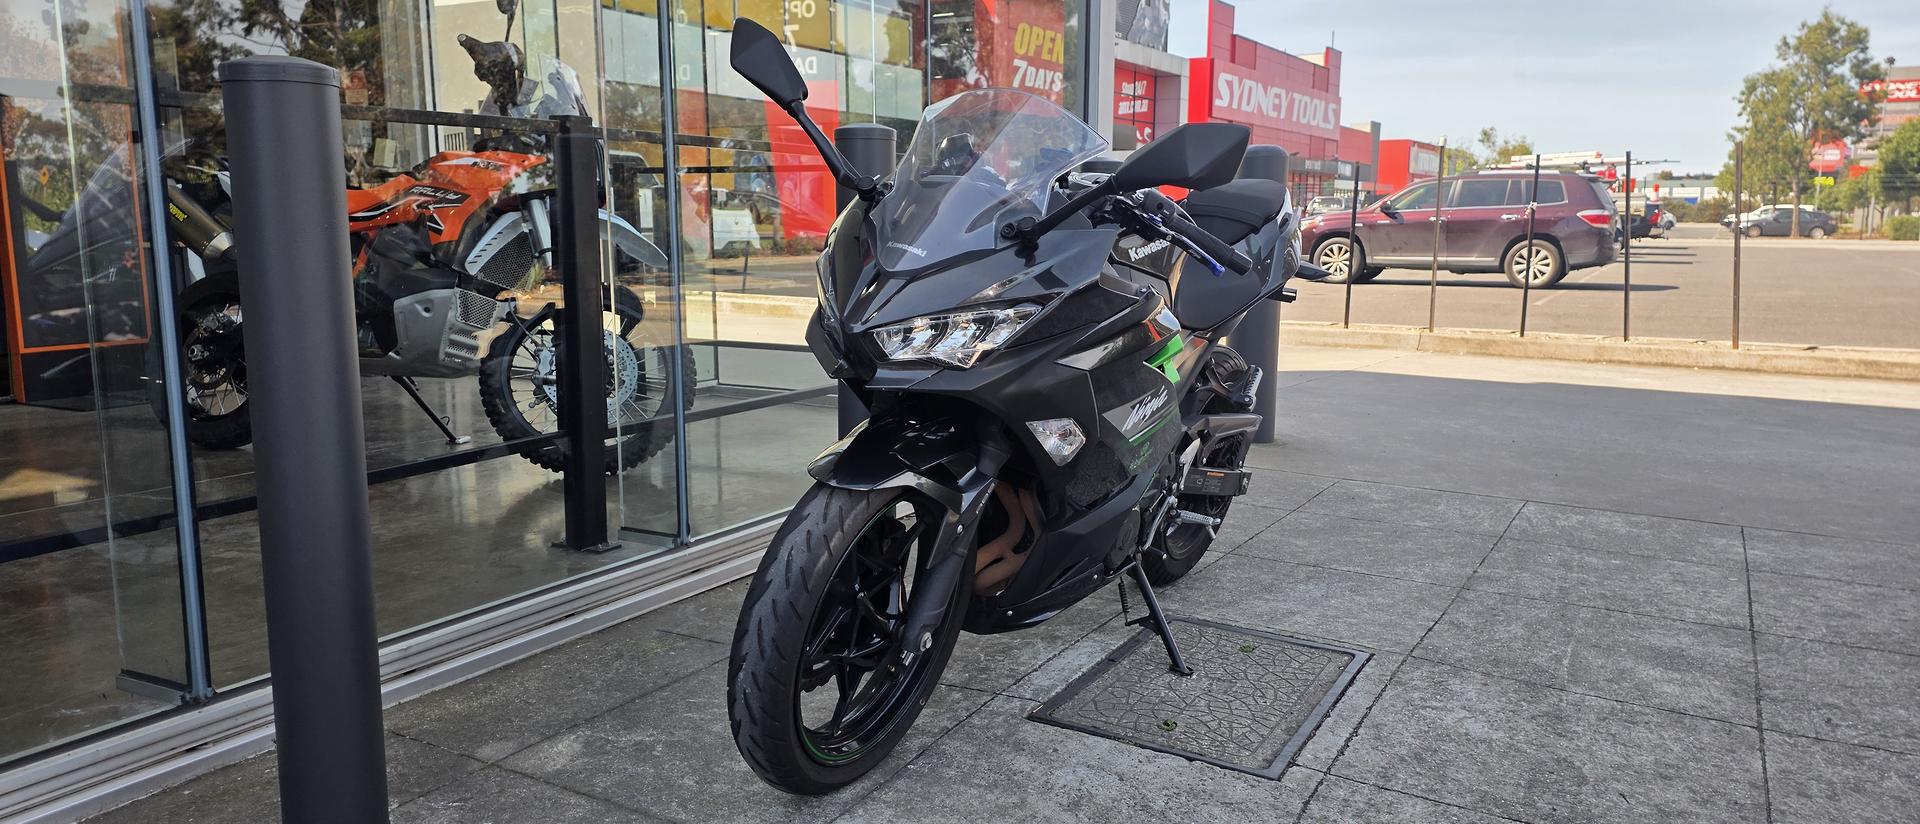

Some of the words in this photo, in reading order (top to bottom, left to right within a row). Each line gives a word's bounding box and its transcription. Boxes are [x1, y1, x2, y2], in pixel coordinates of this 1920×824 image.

[1014, 22, 1064, 64] OPEN
[1215, 72, 1291, 119] SYDNEY
[1292, 92, 1337, 129] TOOLS
[409, 186, 462, 200] RALLY
[886, 241, 928, 257] Kawasaki
[1128, 239, 1170, 262] Kawasa
[1122, 385, 1168, 431] Ninja
